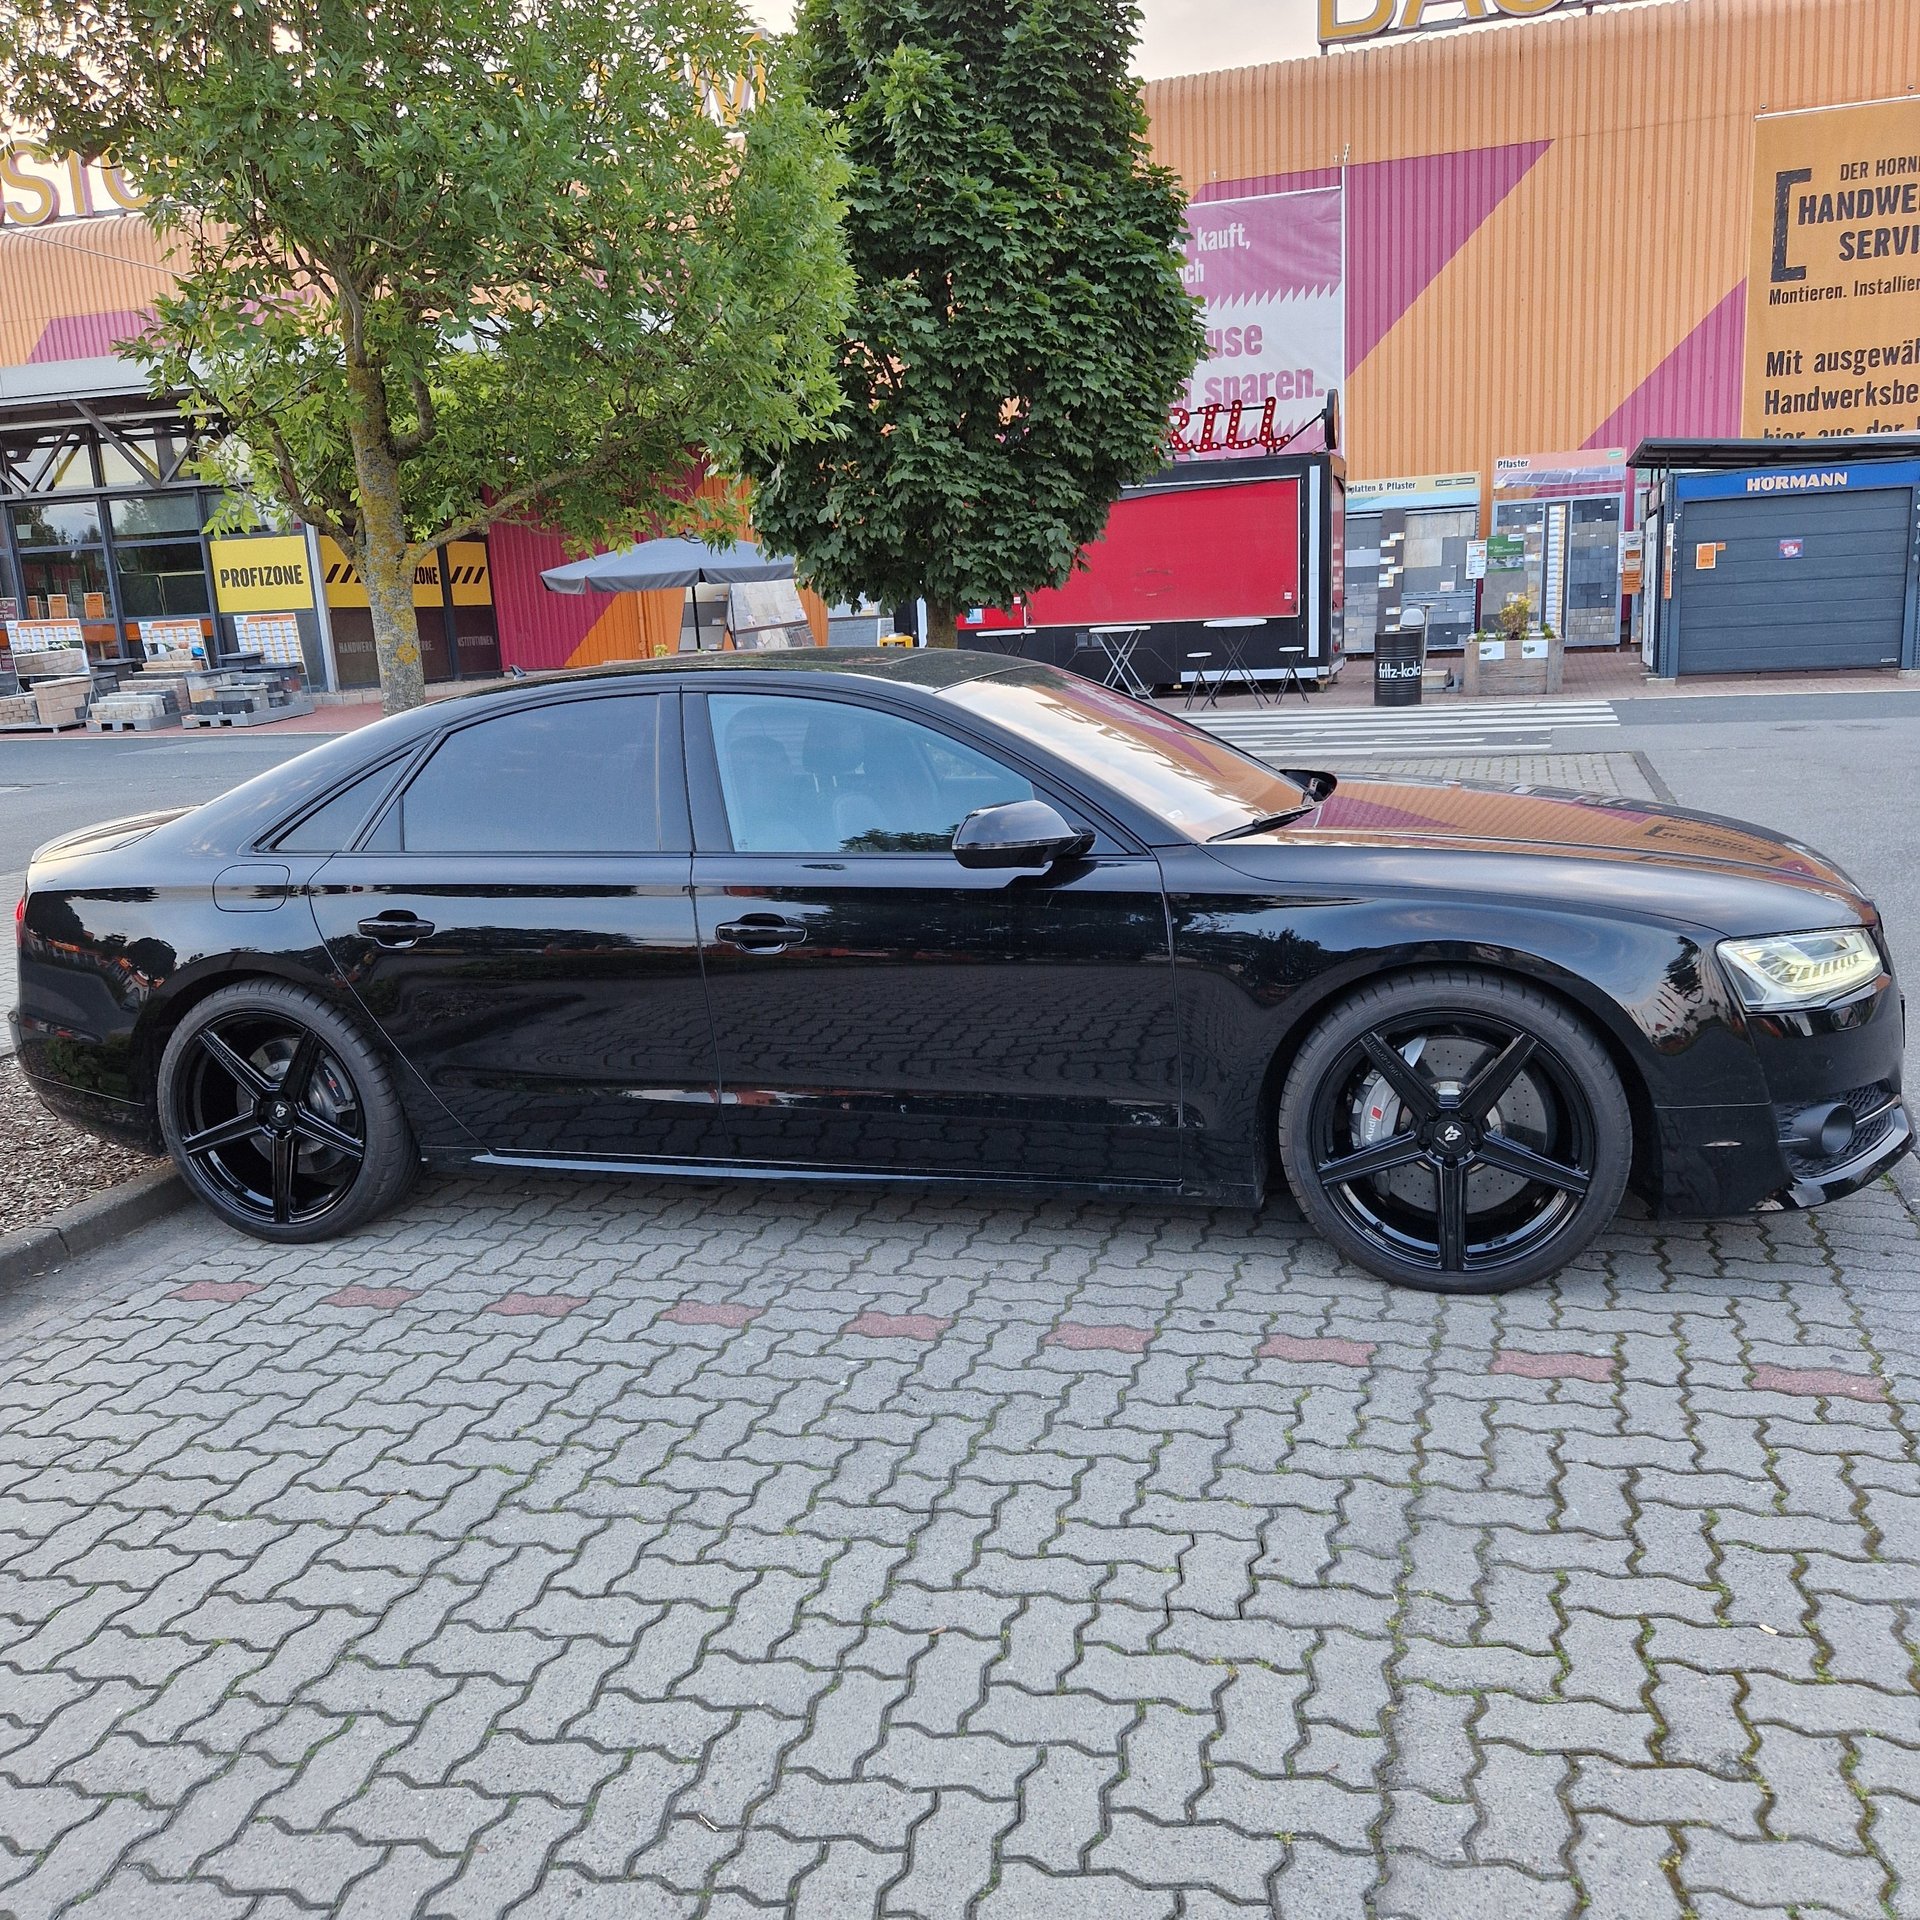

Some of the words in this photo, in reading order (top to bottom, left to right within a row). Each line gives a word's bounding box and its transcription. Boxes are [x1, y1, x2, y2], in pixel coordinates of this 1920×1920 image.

[1840, 161, 1869, 181] DER
[1875, 155, 1920, 176] HORN
[1797, 183, 1920, 225] HANDWE
[1197, 222, 1251, 252] kauft,
[1839, 224, 1920, 261] SERVI
[1769, 285, 1847, 306] Montieren.
[1766, 350, 1803, 377] Mit
[1204, 367, 1325, 414] sparen.
[1765, 379, 1918, 415] Handwerksbe
[1497, 459, 1529, 469] Pflaster
[1379, 483, 1384, 491] &
[1387, 481, 1416, 491] Pflaster
[1747, 472, 1848, 492] HÖRMANN
[220, 564, 304, 589] PROFIZONE
[1379, 660, 1421, 679] fritz-kola
[1365, 1118, 1377, 1142] Audi
